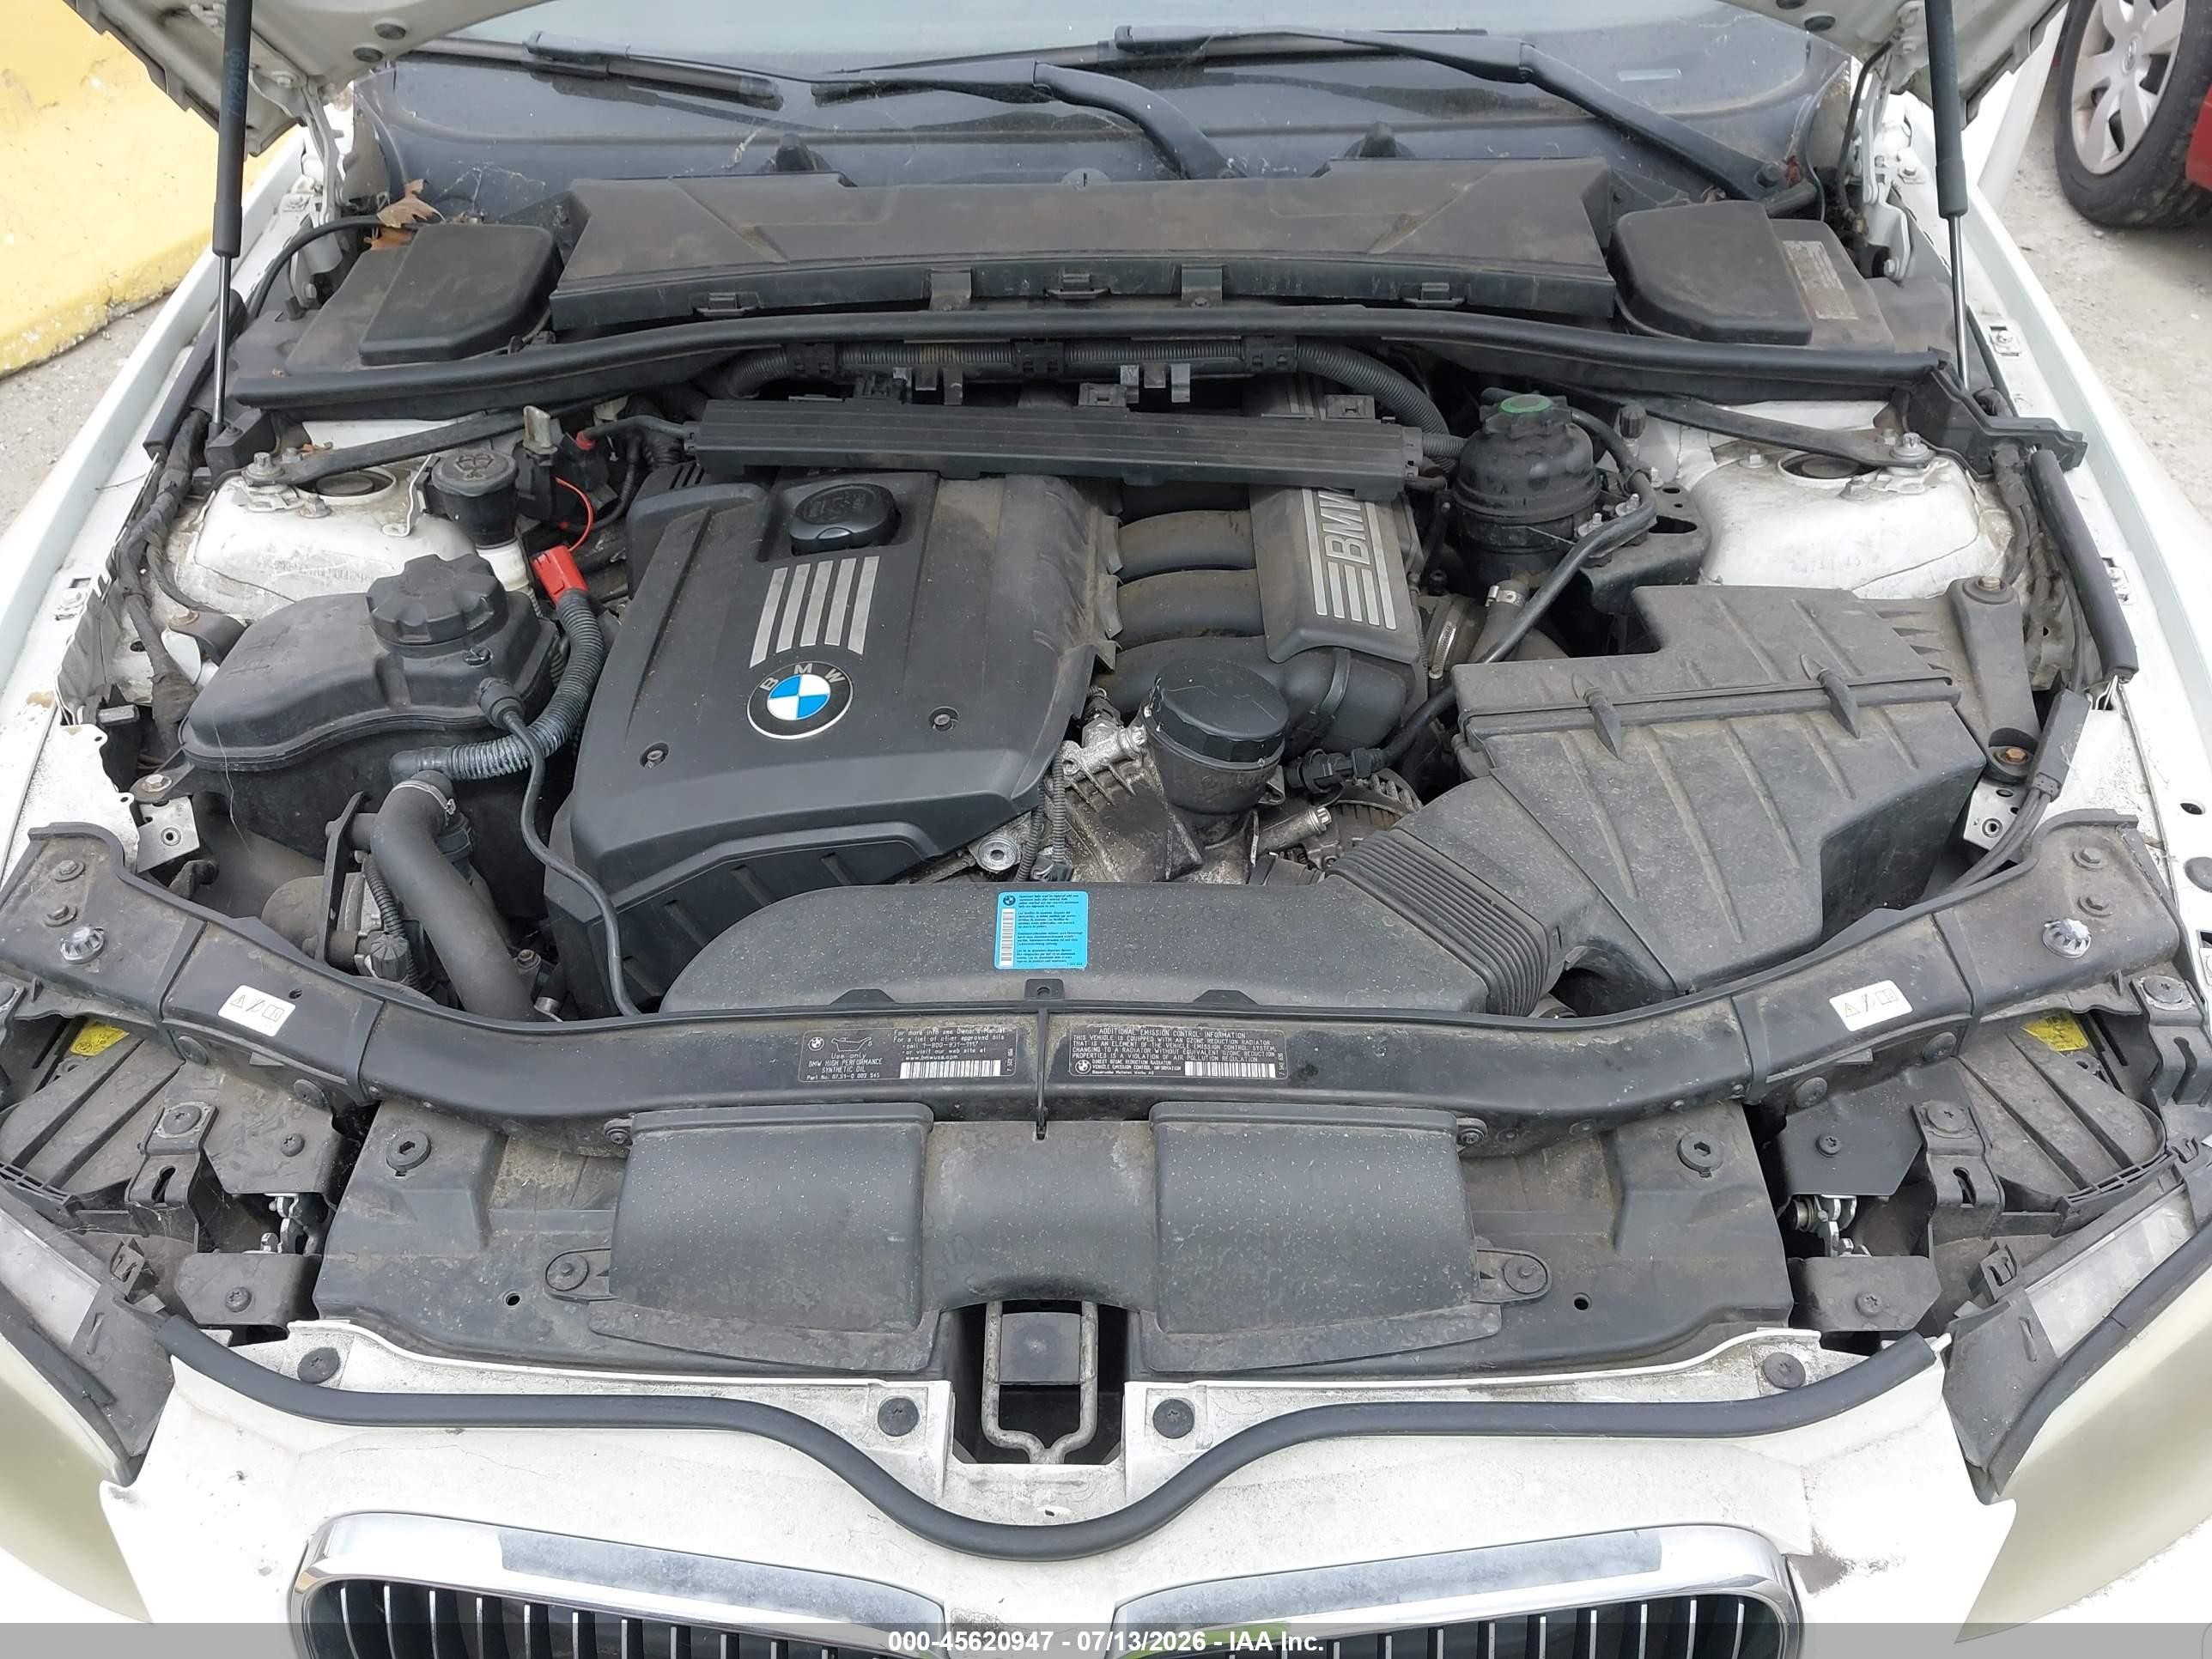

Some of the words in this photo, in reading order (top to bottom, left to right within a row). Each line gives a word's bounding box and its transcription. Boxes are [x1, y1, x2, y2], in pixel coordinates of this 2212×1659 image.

[1318, 488, 1371, 565] BMW
[759, 663, 846, 692] BMW
[961, 1033, 988, 1042] approved
